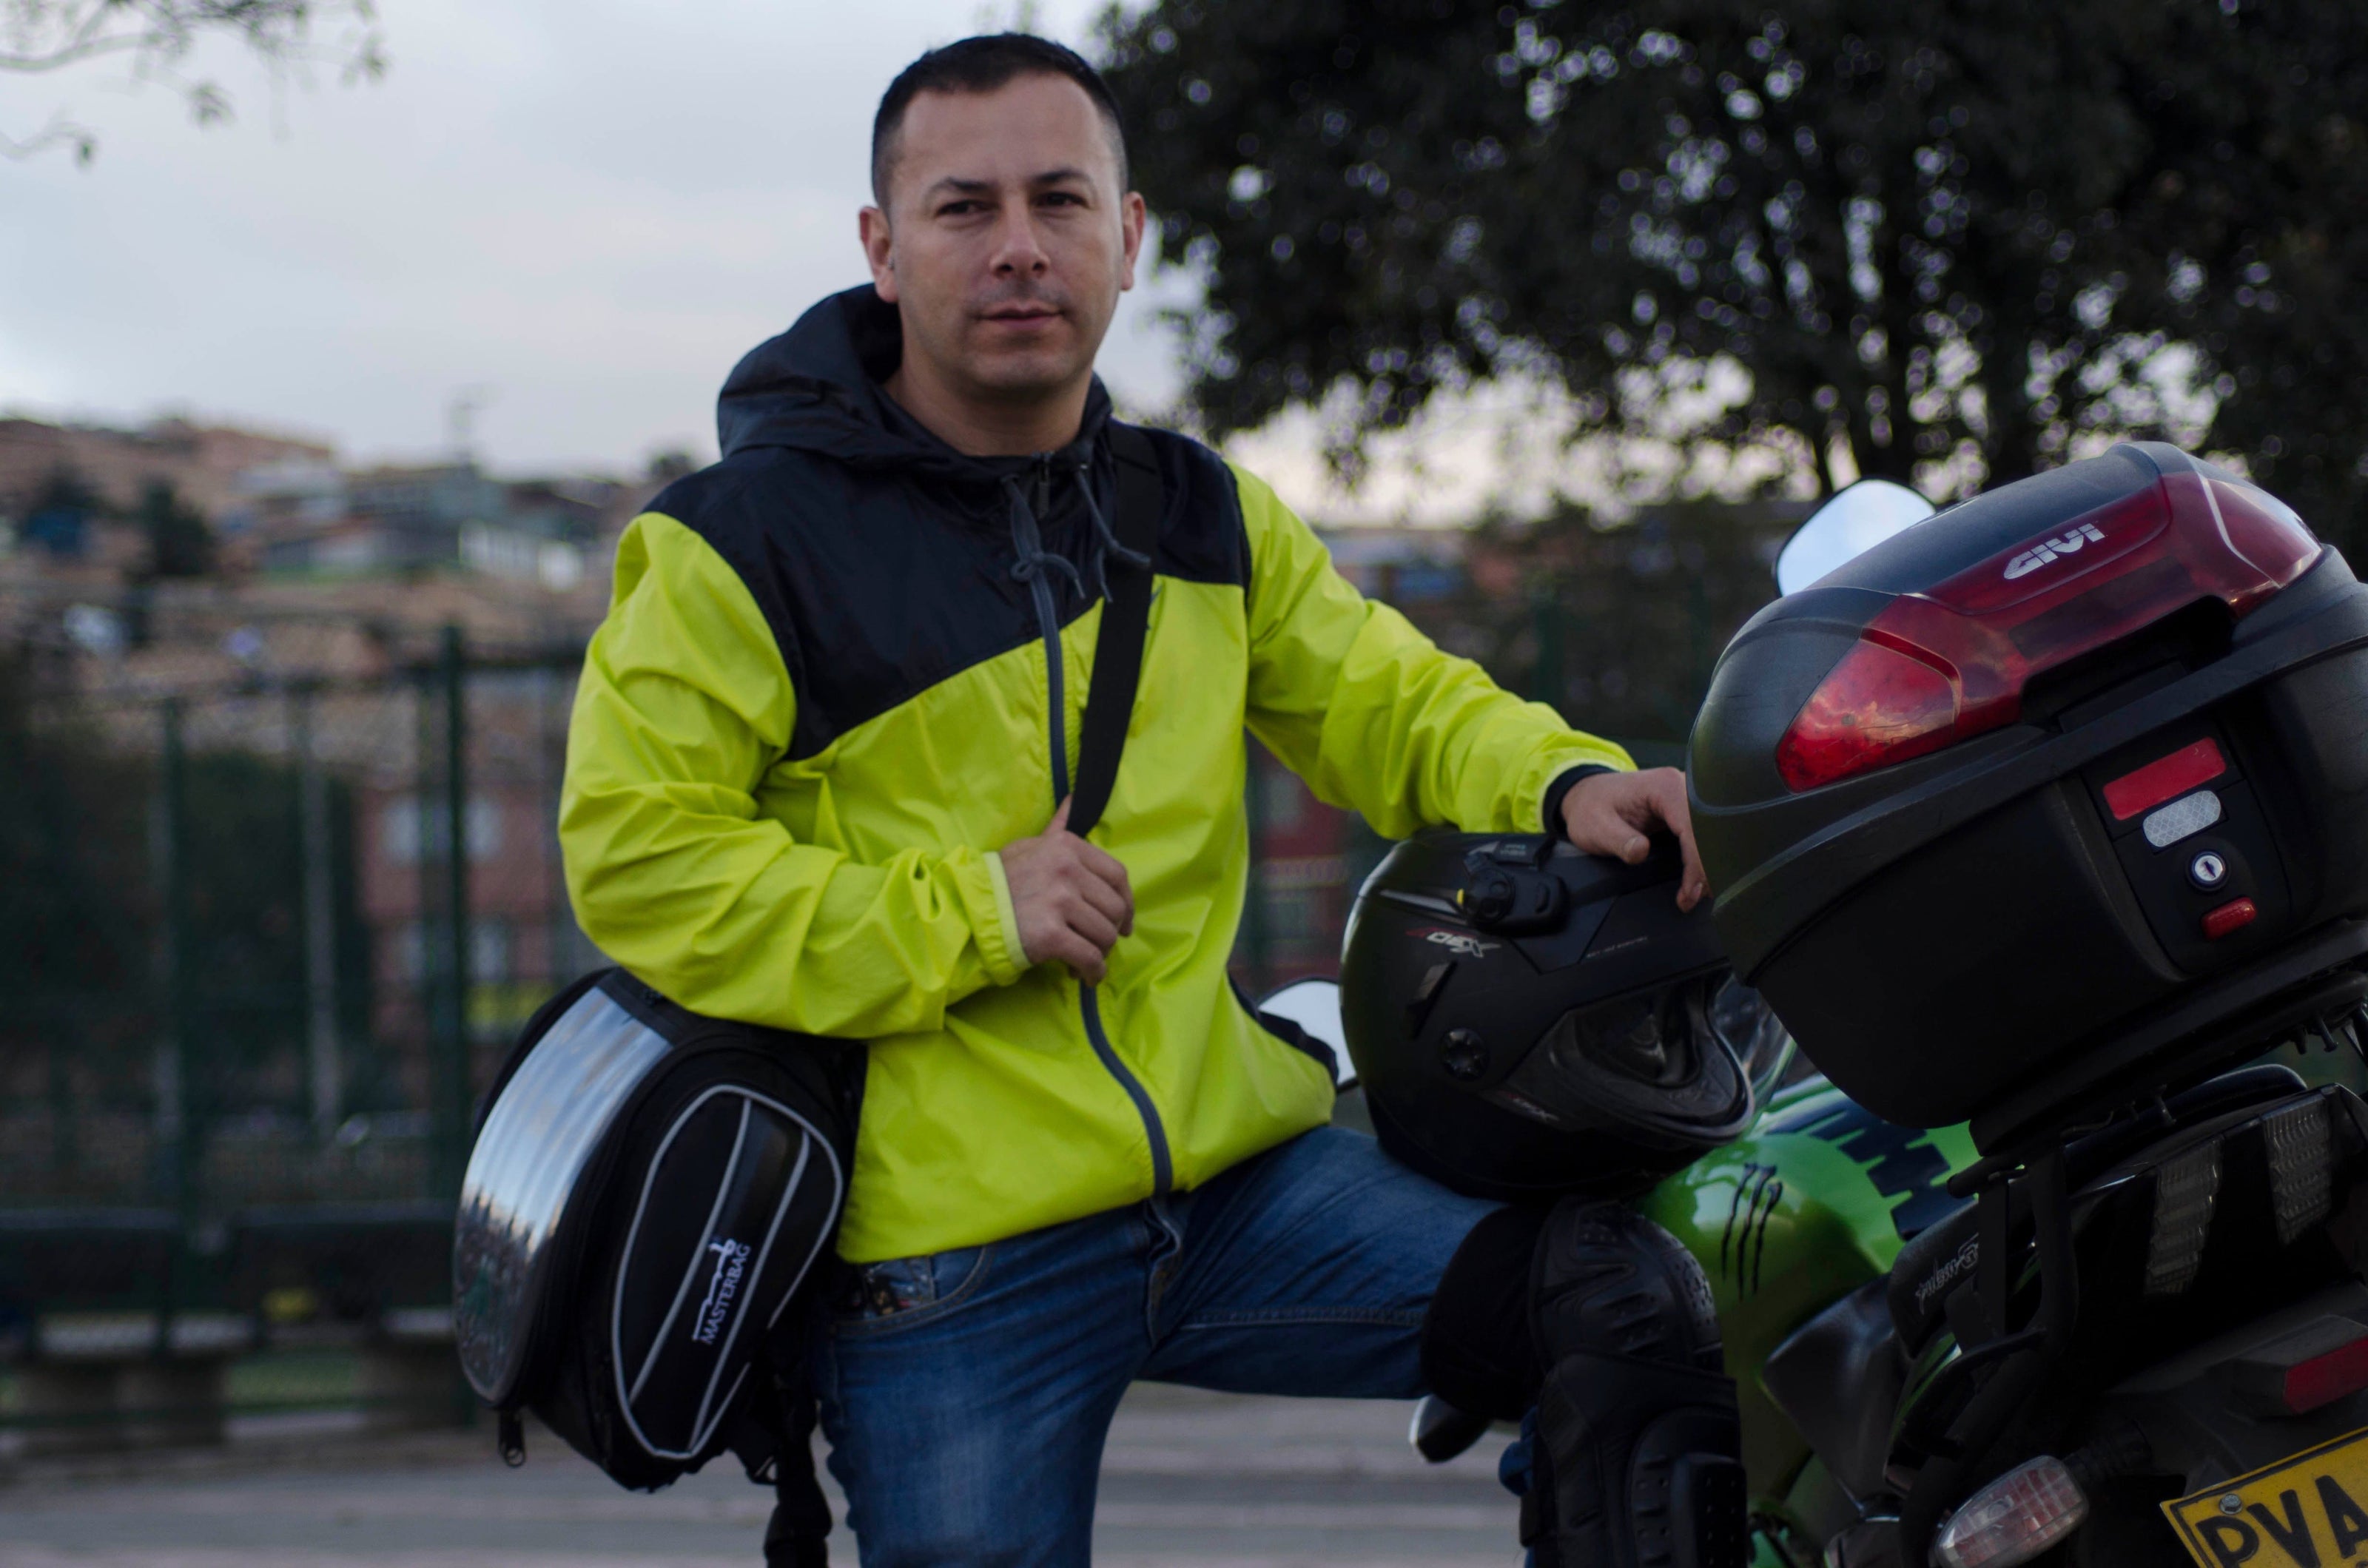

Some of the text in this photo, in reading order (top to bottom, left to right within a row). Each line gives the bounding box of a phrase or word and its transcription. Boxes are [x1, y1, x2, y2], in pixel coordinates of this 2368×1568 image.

[2003, 522, 2106, 580] GIVI
[699, 1242, 752, 1345] MASTERBAG
[2195, 1475, 2368, 1568] PVA
